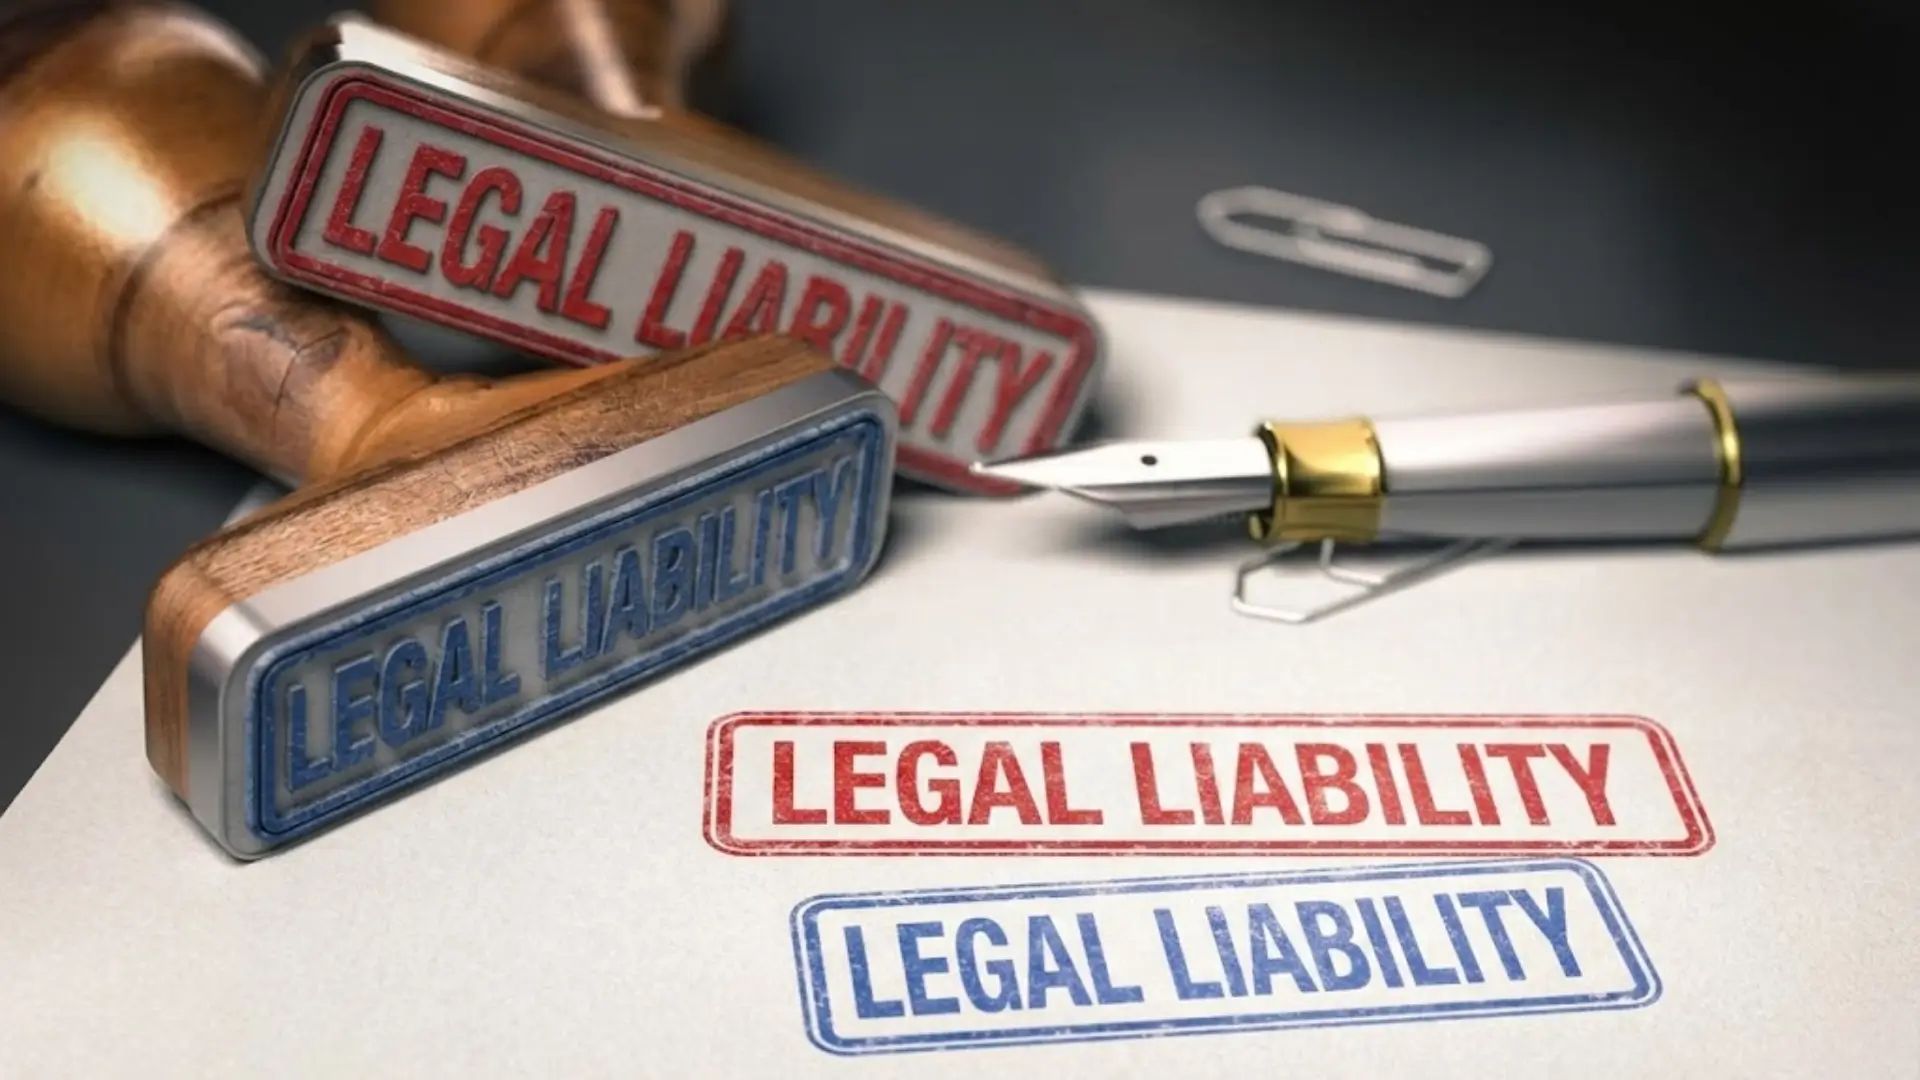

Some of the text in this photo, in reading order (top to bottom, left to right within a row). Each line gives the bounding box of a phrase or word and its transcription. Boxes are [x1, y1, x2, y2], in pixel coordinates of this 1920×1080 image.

[323, 127, 619, 328] LEGAL
[287, 458, 855, 792] LEGAL LIABILITY
[773, 740, 1616, 827] LEGAL LIABILITY
[844, 886, 1582, 1020] LEGAL LIABILITY
